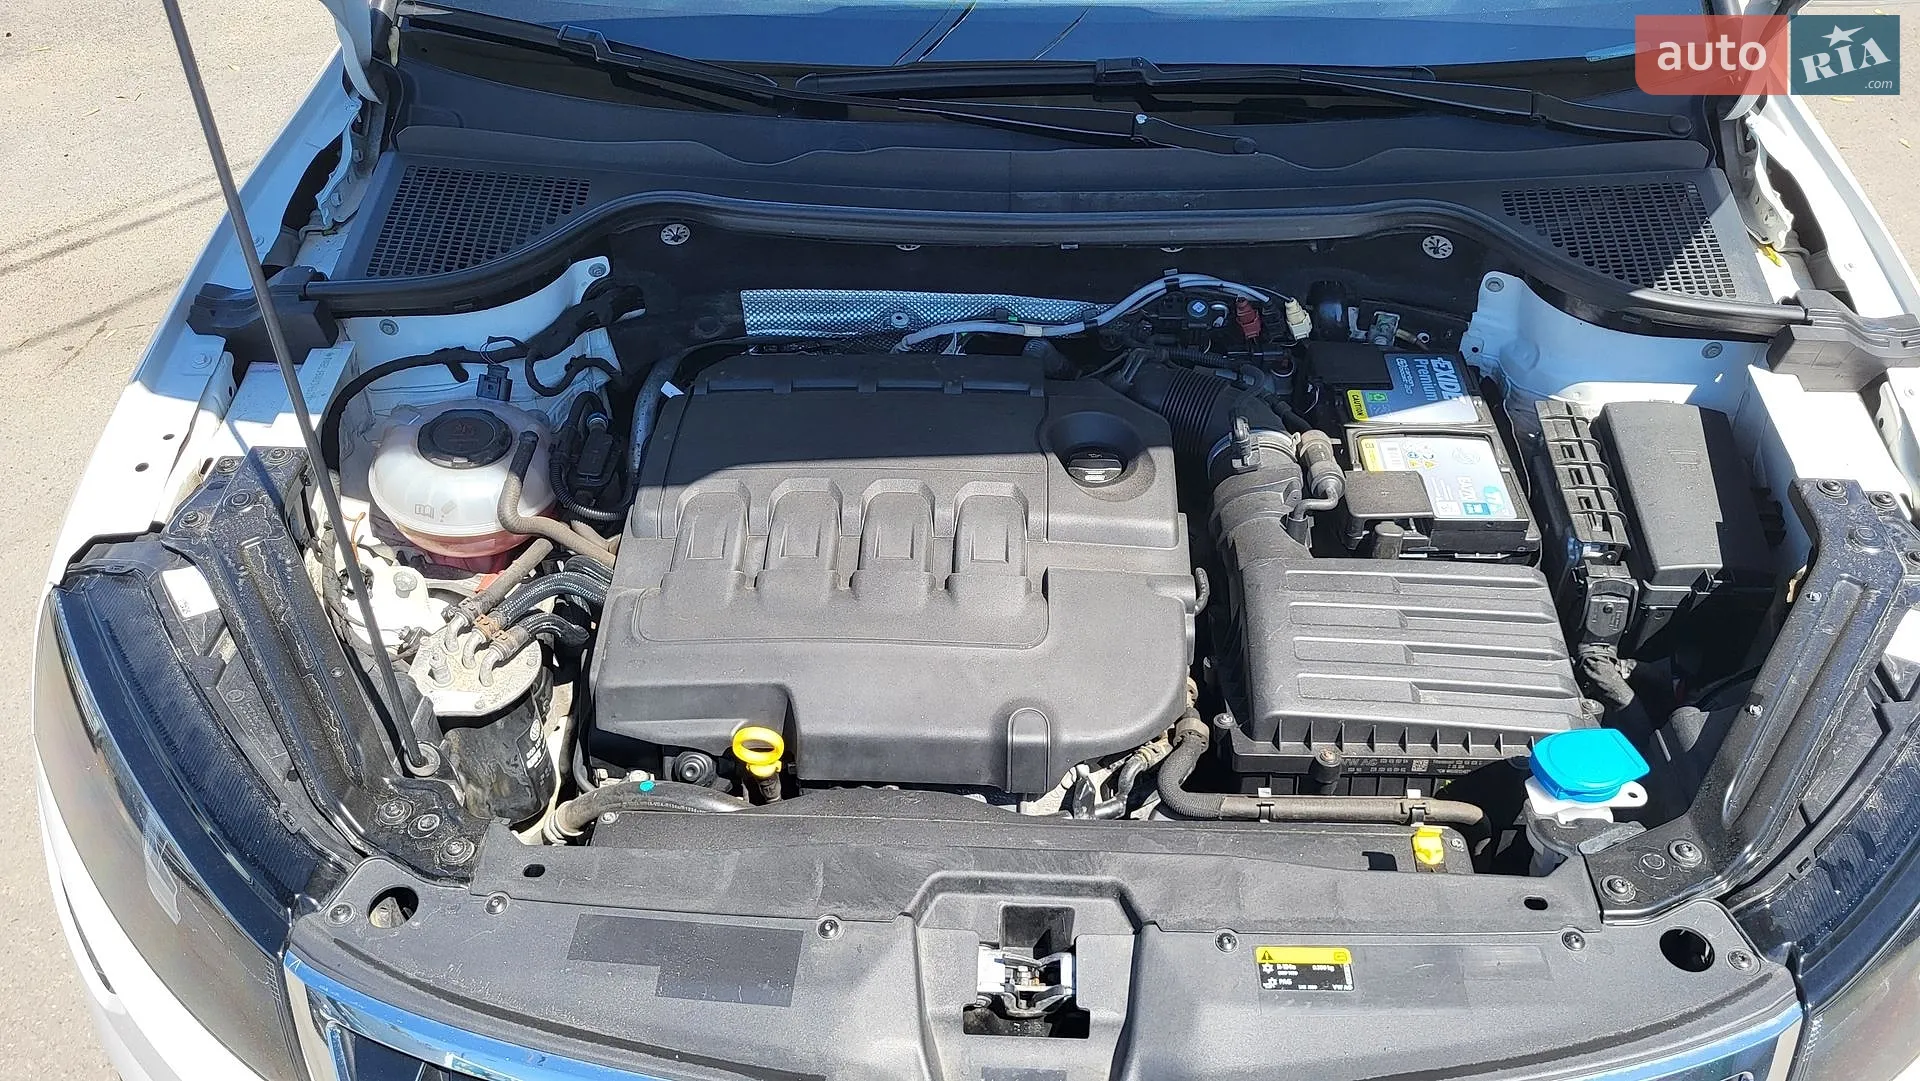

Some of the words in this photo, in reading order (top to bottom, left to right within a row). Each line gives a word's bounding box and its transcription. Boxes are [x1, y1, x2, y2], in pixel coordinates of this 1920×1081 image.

[1414, 358, 1439, 401] Premium
[1430, 357, 1464, 404] EXIDE
[1351, 394, 1365, 417] CAUTION
